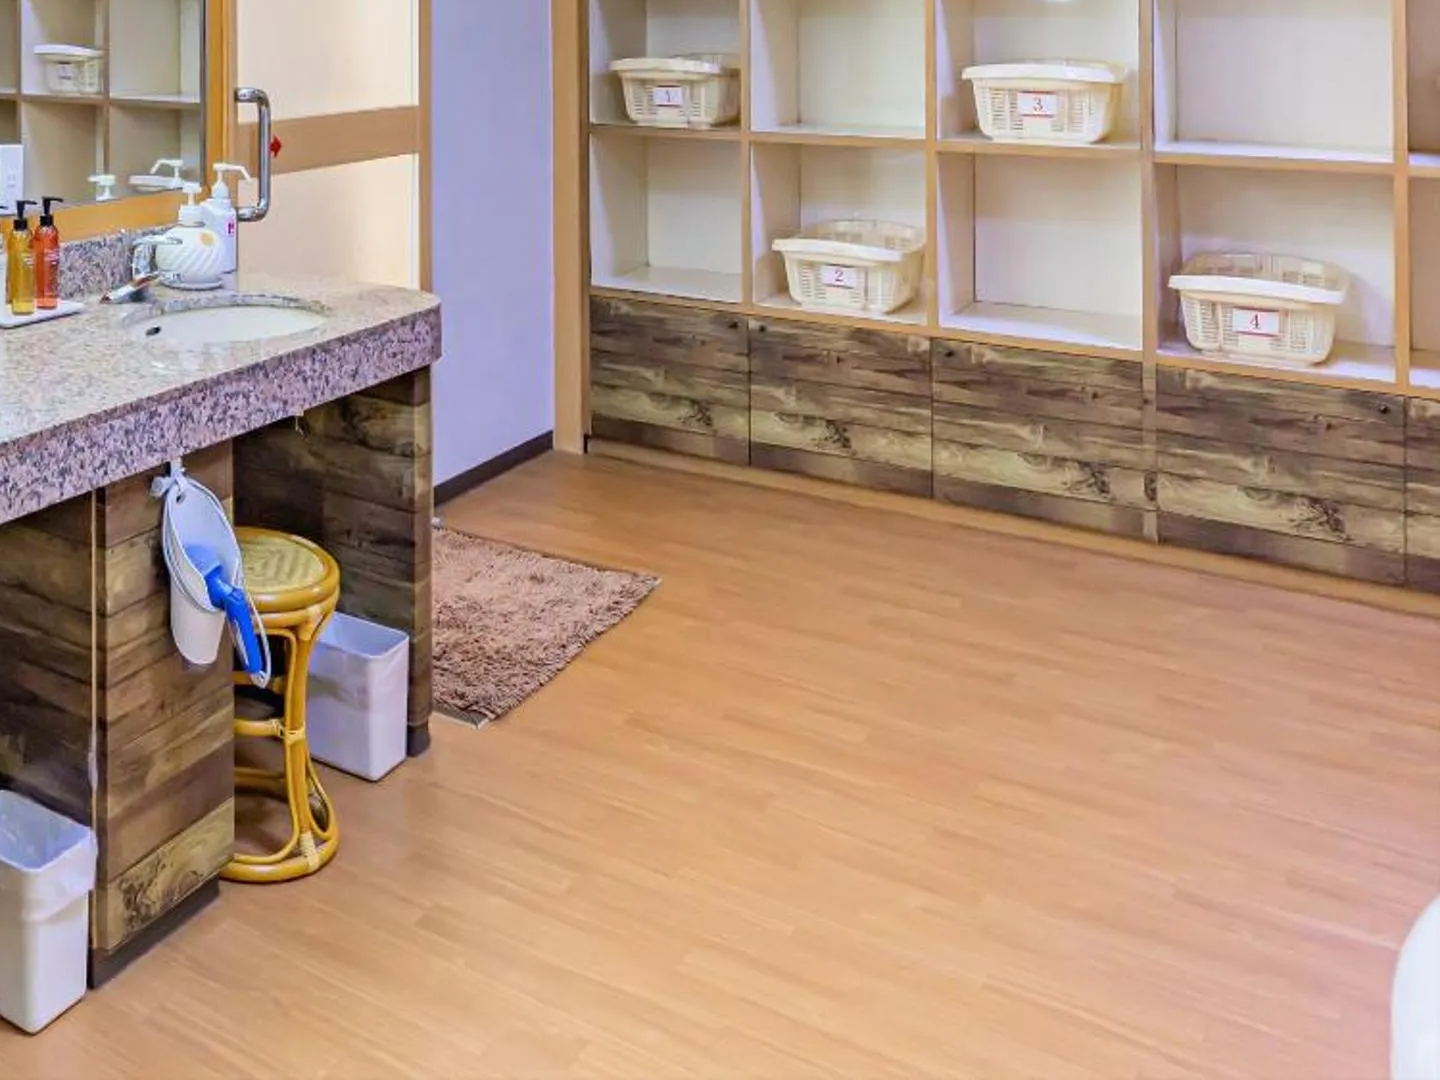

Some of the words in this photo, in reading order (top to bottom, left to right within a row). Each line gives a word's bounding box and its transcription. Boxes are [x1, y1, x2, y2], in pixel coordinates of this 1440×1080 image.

[1033, 96, 1043, 111] 3
[835, 269, 844, 283] 2
[1249, 314, 1260, 329] 4
